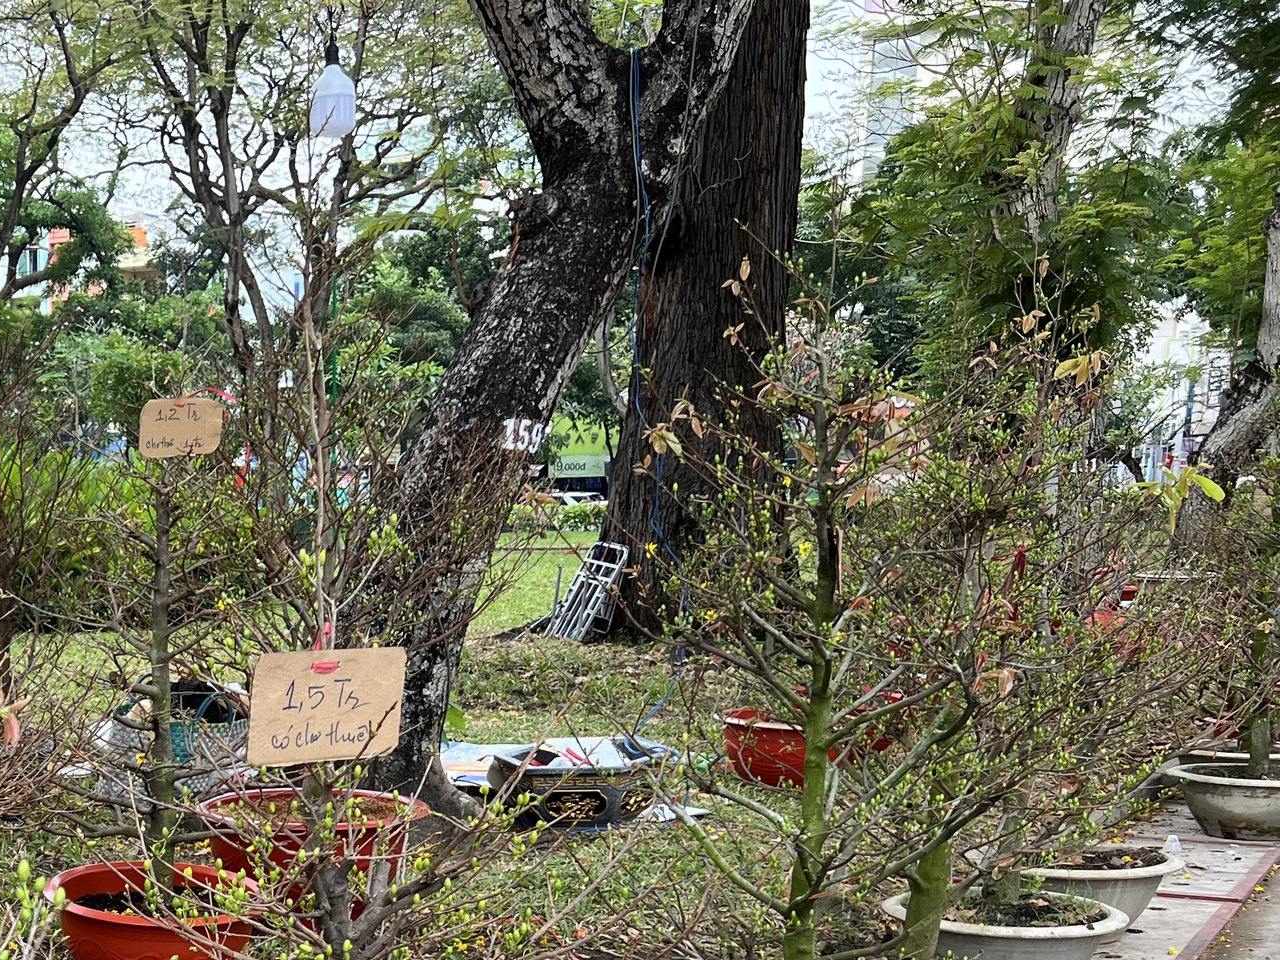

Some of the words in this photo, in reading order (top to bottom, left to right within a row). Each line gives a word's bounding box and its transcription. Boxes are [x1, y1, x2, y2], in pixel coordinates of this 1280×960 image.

[154, 408, 180, 422] 1,2
[186, 402, 202, 421] Tr
[502, 418, 544, 454] 159
[282, 679, 325, 713] 1,5
[334, 678, 371, 710] Tr
